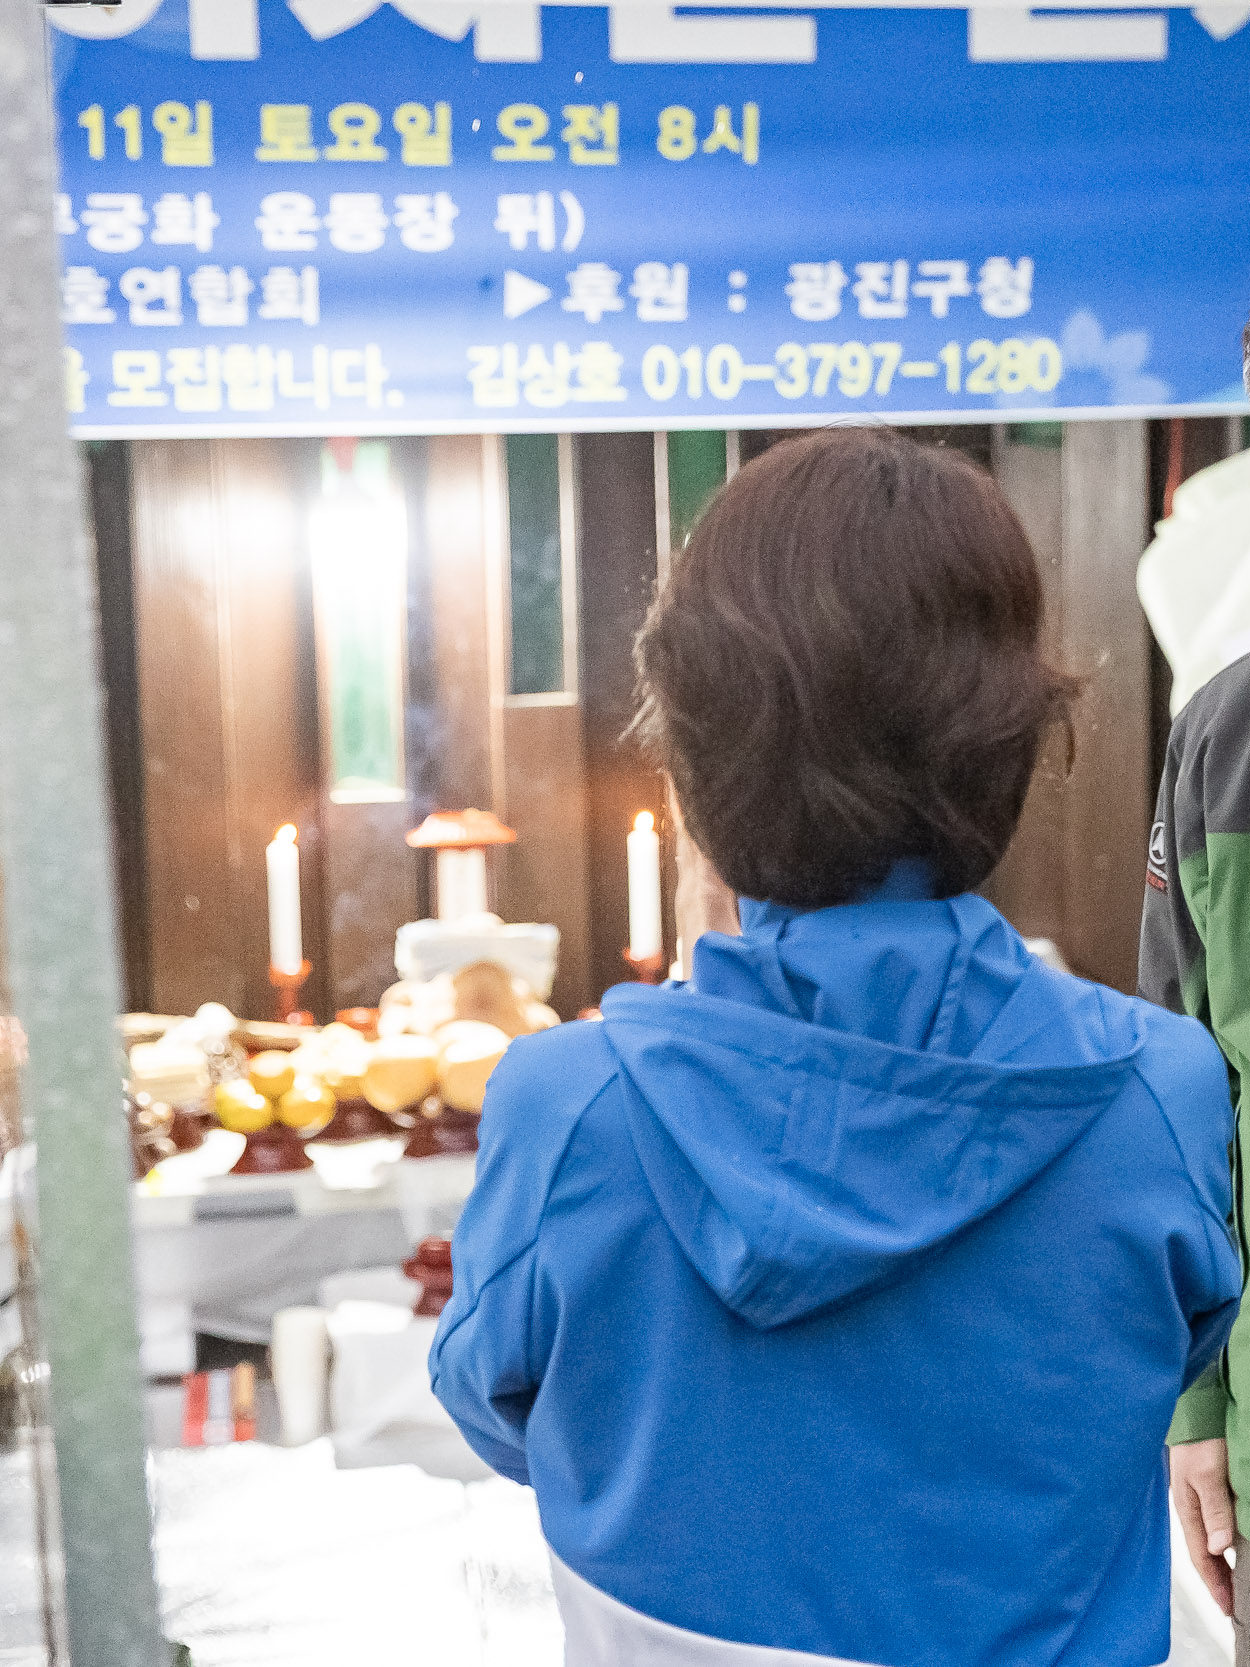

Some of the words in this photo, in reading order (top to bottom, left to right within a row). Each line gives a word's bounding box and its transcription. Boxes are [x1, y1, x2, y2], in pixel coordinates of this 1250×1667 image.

[77, 101, 214, 166] 11일
[255, 101, 453, 167] 토요일
[492, 101, 620, 166] 오전
[656, 101, 760, 165] 8시
[255, 191, 458, 253] 운동장
[563, 262, 690, 323] 후원
[785, 256, 1035, 322] 광진구청
[107, 344, 404, 412] 모집합니다.
[467, 342, 628, 412] 김상호
[641, 338, 1063, 402] 010-3797-1280
